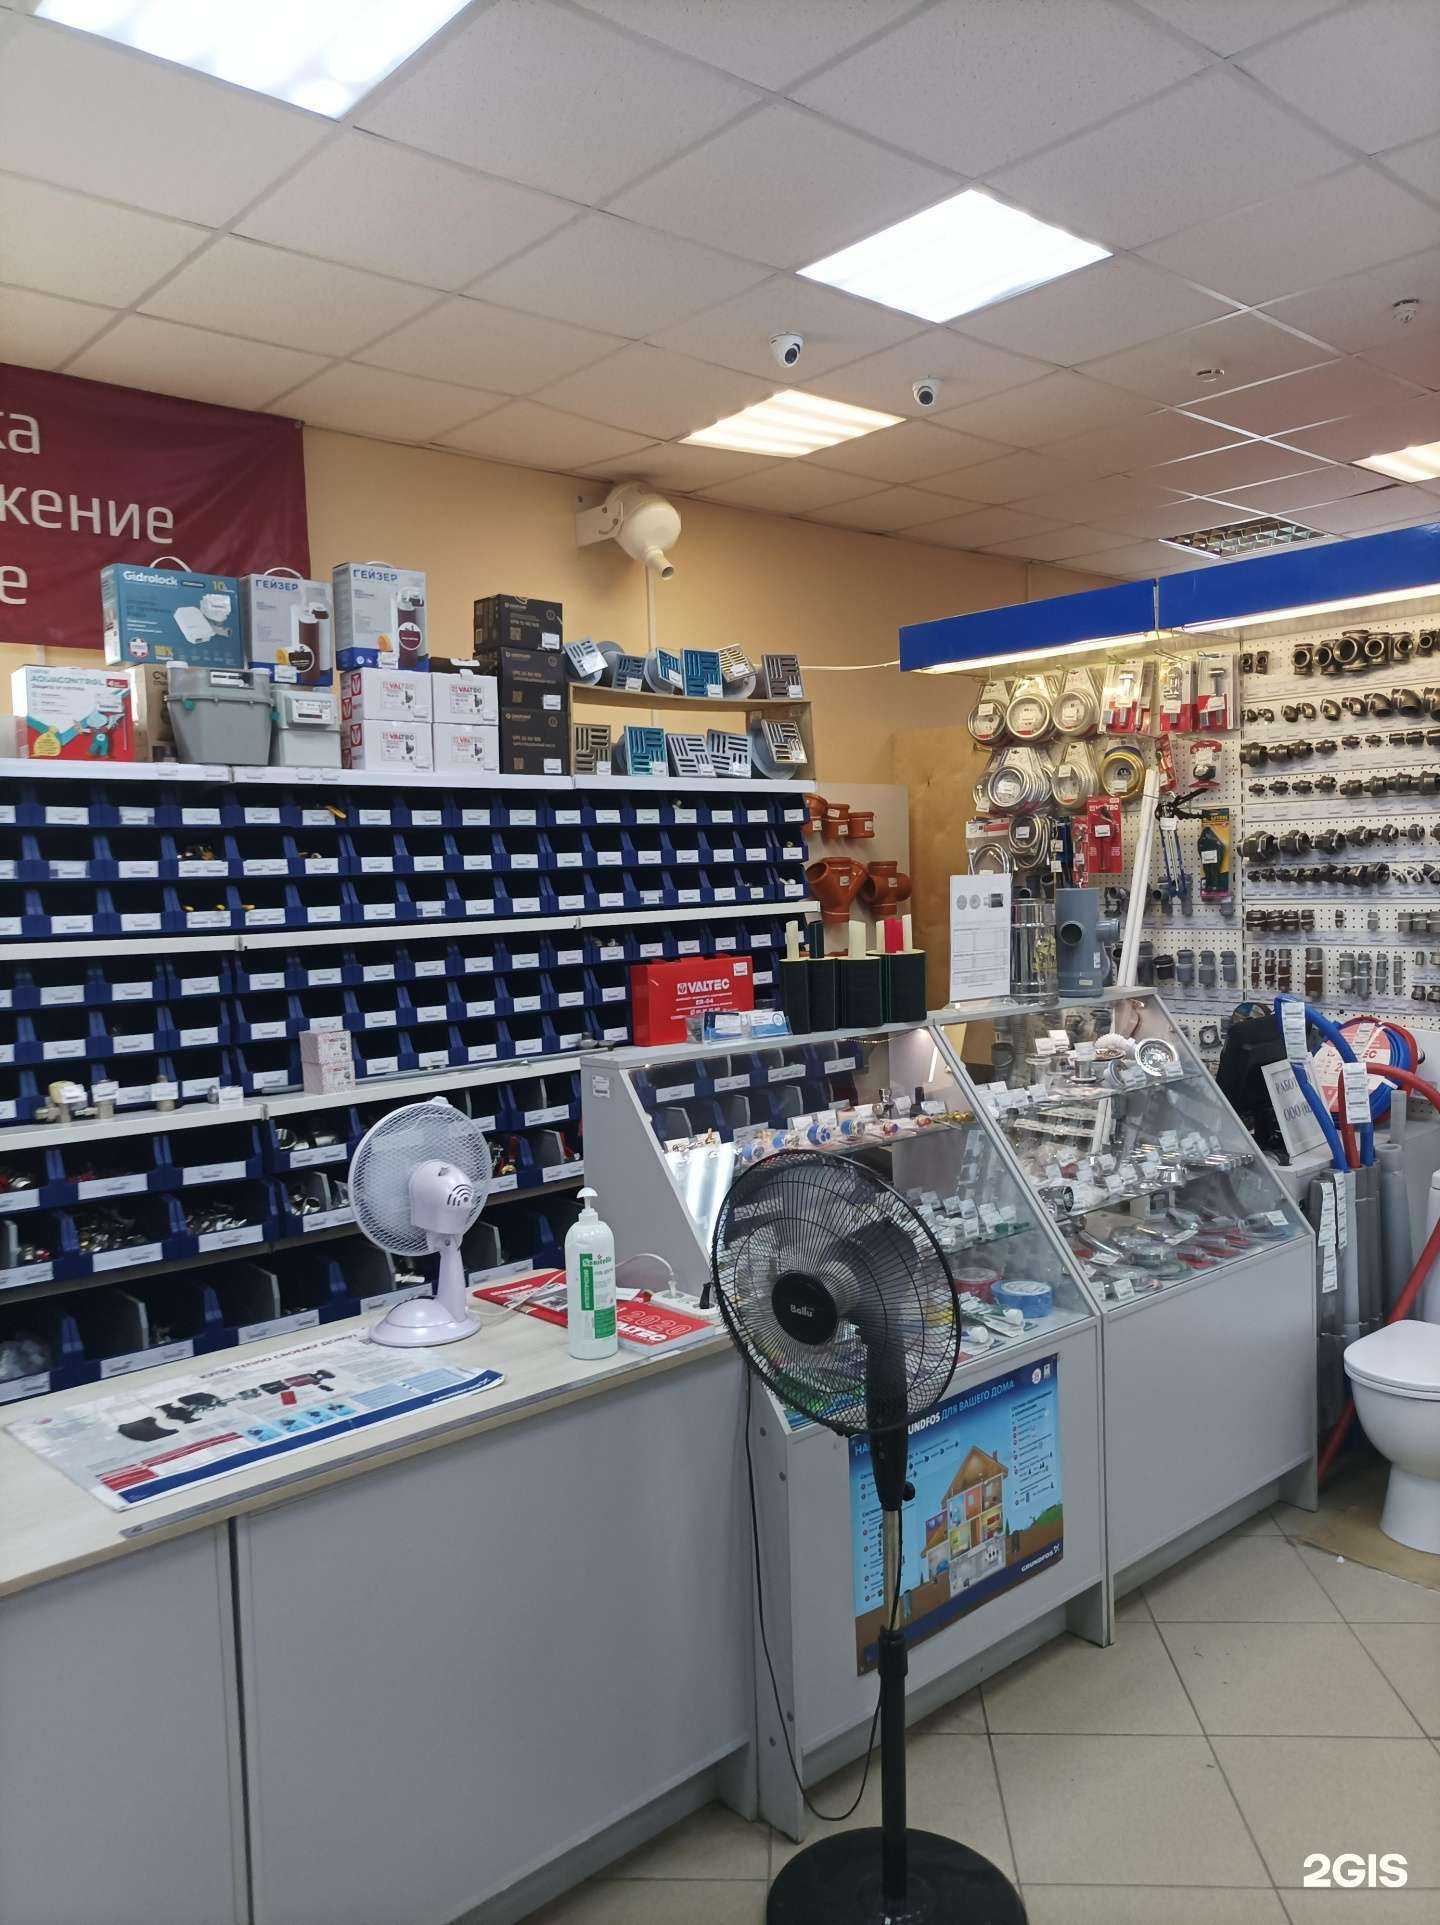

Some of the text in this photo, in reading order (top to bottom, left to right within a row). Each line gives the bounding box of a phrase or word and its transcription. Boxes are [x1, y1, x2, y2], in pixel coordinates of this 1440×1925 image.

[123, 570, 178, 586] Gidrolock
[353, 568, 399, 581] ГЕЙЗЕР
[255, 579, 299, 592] ГЕЙЗЕР
[686, 978, 730, 993] VALTEC
[790, 1304, 813, 1318] Ballu
[908, 1412, 940, 1435] UNDFOS
[941, 1404, 958, 1421] ДЛЯ
[959, 1390, 991, 1411] ВАШЕГО
[991, 1379, 1014, 1398] ДОМА
